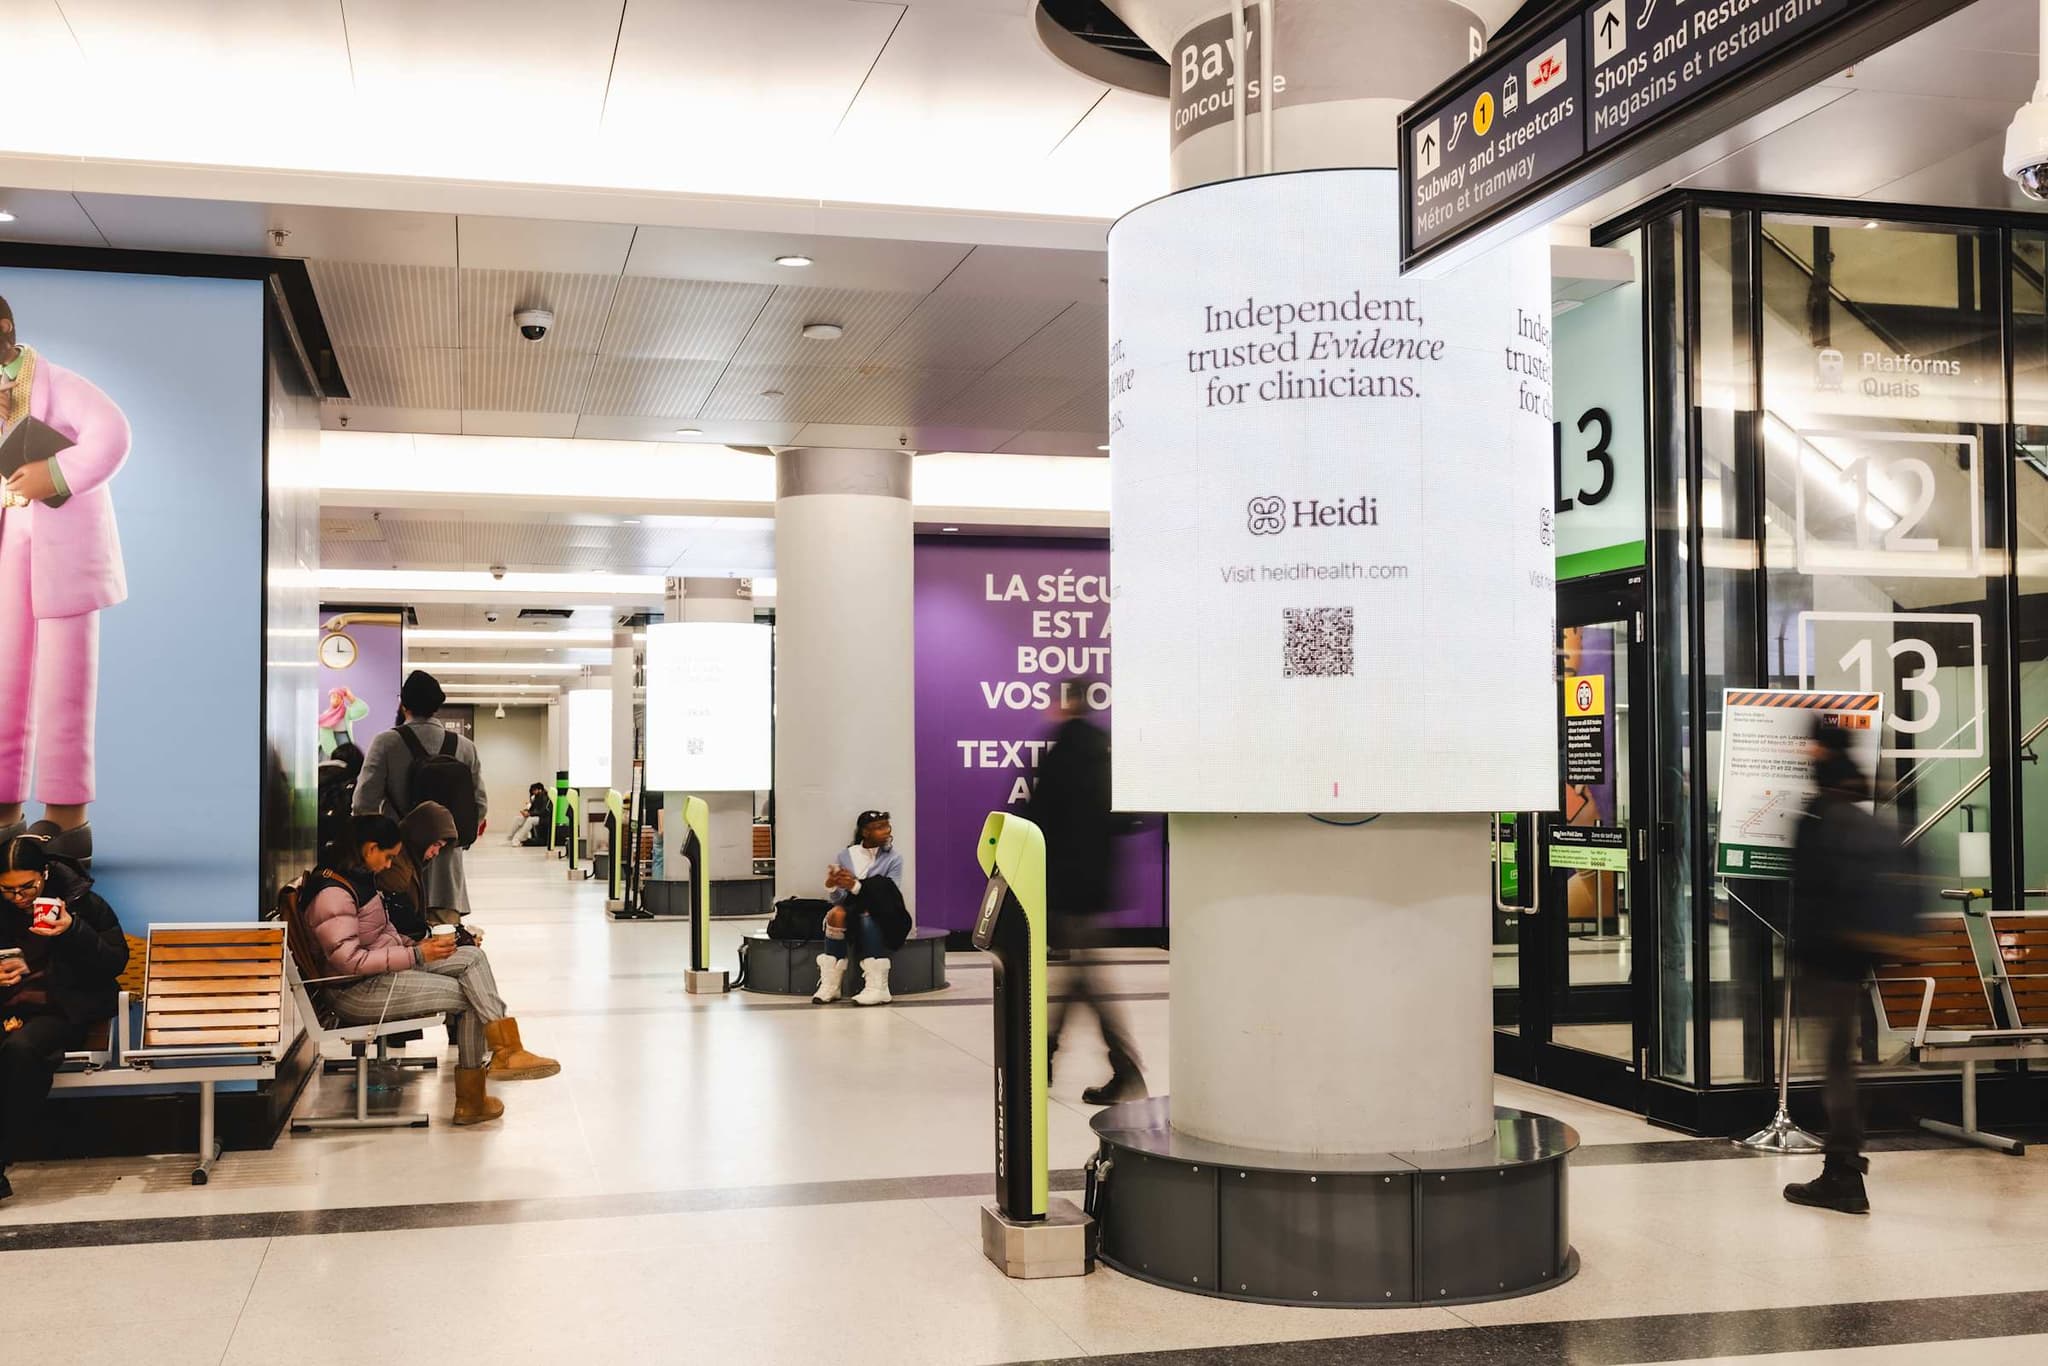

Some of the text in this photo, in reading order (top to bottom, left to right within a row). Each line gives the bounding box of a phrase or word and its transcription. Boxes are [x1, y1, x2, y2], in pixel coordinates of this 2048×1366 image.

[1595, 0, 1759, 99] Shops and Resta
[1595, 0, 1821, 134] Magasins et restauran
[1175, 75, 1286, 131] Concouse
[1479, 103, 1486, 125] 1
[1417, 97, 1574, 206] Subway and streetcars
[1417, 153, 1535, 236] Métro et tramway
[1204, 289, 1423, 334] Independent,
[1187, 328, 1445, 373] trusted Evidence
[1863, 352, 1961, 376] Platforms
[1207, 368, 1421, 407] for clinicians.
[1519, 380, 1541, 415] for
[1863, 377, 1920, 398] Quais
[1293, 496, 1379, 528] Heidi
[1839, 456, 1939, 551] 12
[986, 573, 1030, 602] LA
[1221, 562, 1409, 583] Visit heidihealth.com
[1033, 611, 1093, 639] EST
[1018, 646, 1110, 674] BOUT
[980, 681, 1051, 710] VOS
[1838, 638, 1941, 733] 13
[957, 740, 1057, 768] TEXT
